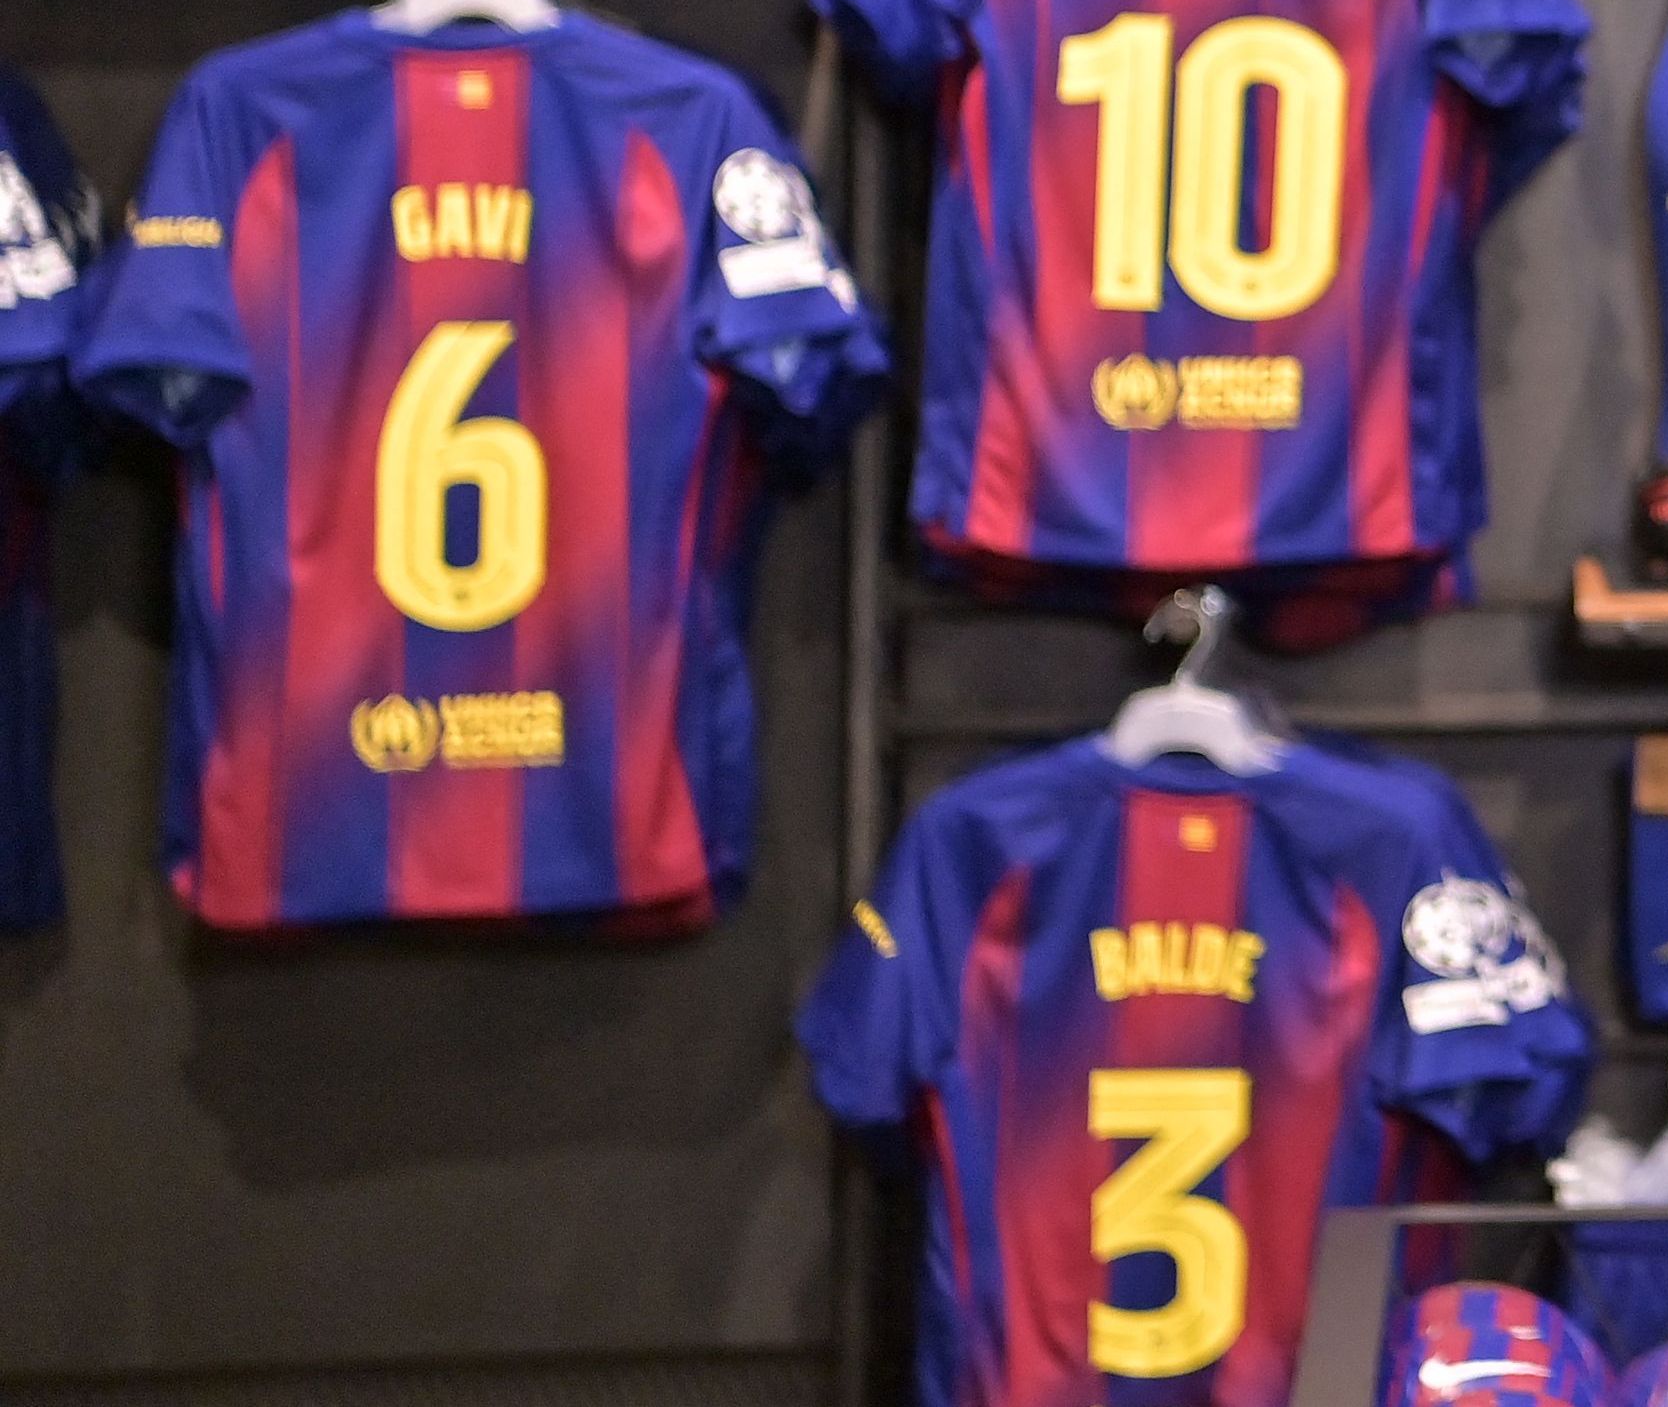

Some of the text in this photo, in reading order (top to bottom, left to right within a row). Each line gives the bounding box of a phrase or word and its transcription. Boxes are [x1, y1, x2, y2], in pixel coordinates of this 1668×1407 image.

[392, 182, 534, 264] GAVI
[1056, 12, 1350, 321] 10
[374, 321, 548, 632] 6
[1089, 921, 1266, 1003] BALDE
[1087, 1068, 1252, 1379] 3
